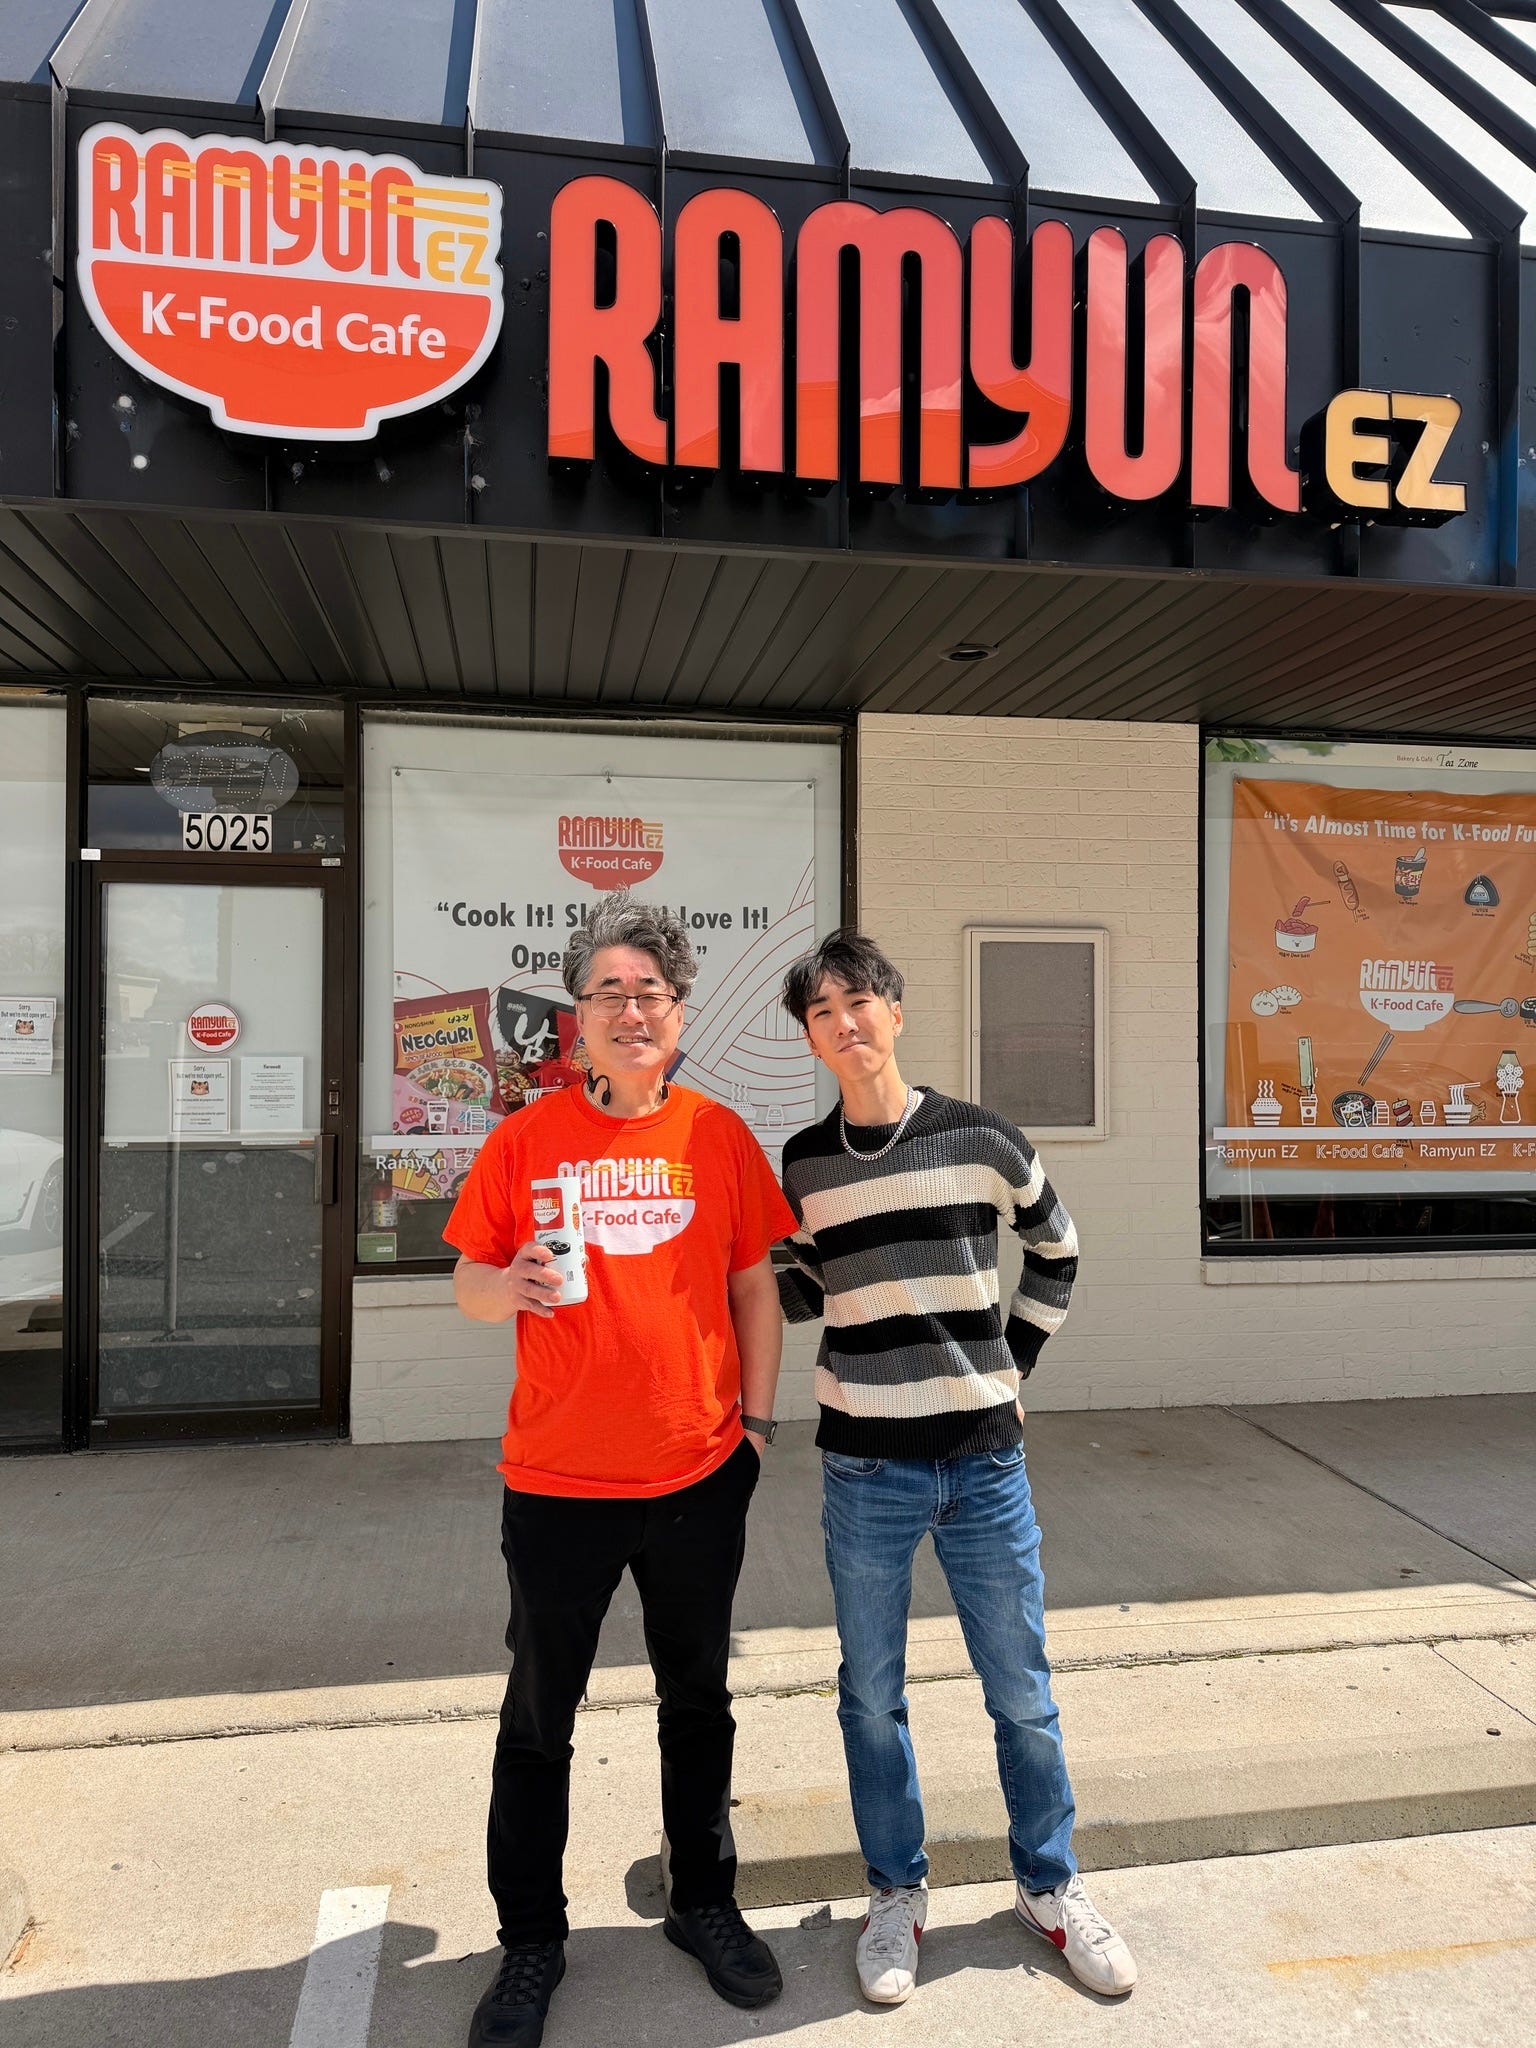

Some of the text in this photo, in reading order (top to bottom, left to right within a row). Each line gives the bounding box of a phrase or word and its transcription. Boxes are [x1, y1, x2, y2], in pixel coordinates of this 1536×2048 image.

[92, 136, 490, 286] RAMYUN EZ
[142, 291, 446, 359] K-Food Cafe
[548, 174, 1467, 514] RAMYUN EZ
[1436, 750, 1454, 767] Tea
[1458, 758, 1479, 768] Zone
[162, 755, 288, 795] OPEN
[185, 814, 270, 851] 5025
[558, 815, 663, 849] RAMYUN EZ
[1304, 815, 1368, 837] Almost
[1374, 819, 1416, 839] Time
[1421, 821, 1446, 840] for
[1452, 823, 1511, 842] K-Food
[571, 856, 652, 870] K-Food Cafe
[526, 903, 554, 928] It!
[742, 906, 768, 930] It!
[1360, 958, 1454, 991] RAMYUN EZ
[1371, 998, 1443, 1011] K-Food Cafe
[191, 1016, 228, 1029] RAMYUN
[401, 1026, 474, 1053] NEOGURI
[376, 1155, 474, 1173] Ramyun EZ
[1217, 1145, 1276, 1161] Ramyun
[1281, 1145, 1298, 1158] EZ
[1316, 1144, 1368, 1159] K-Food
[1372, 1143, 1404, 1159] Cafe
[1420, 1144, 1475, 1160] Ramyun
[1480, 1143, 1497, 1157] EZ
[1512, 1143, 1536, 1157] K-F
[672, 1177, 695, 1197] EZ
[642, 1208, 681, 1225] Cafe
